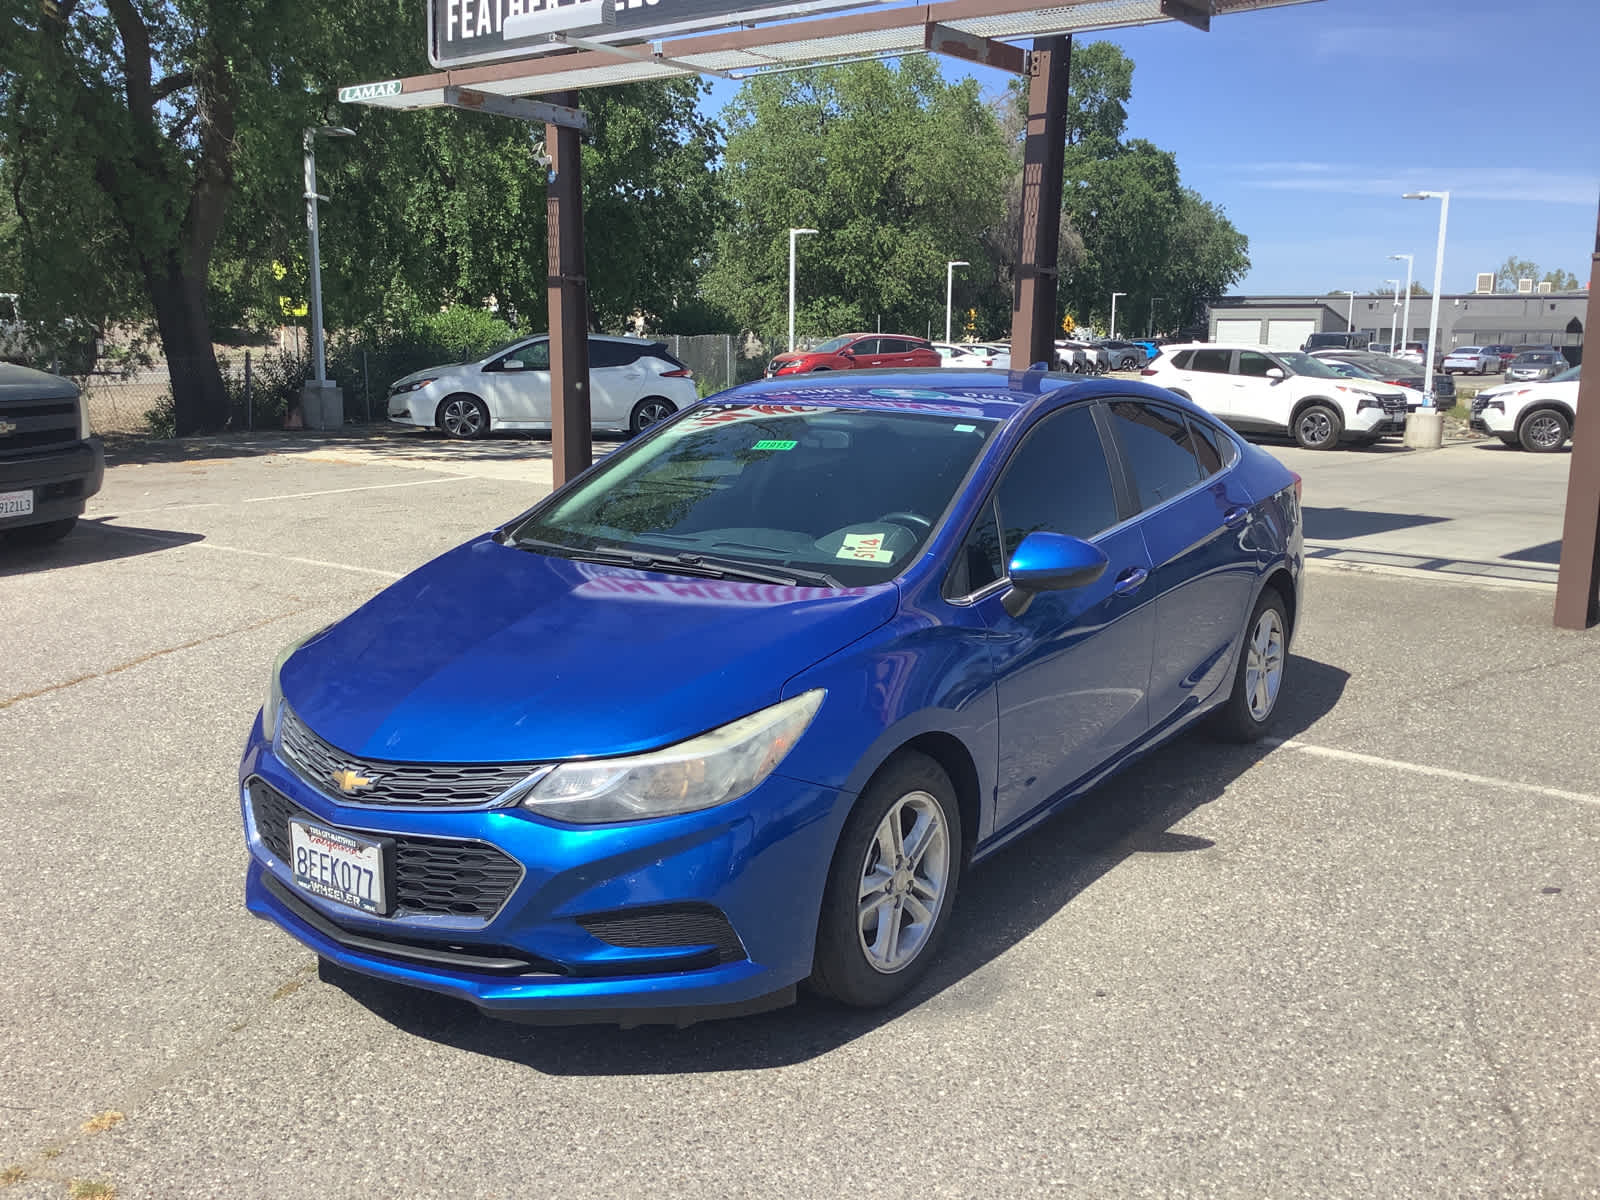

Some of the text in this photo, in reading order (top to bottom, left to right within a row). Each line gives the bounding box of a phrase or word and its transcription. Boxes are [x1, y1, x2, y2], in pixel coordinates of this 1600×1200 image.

[344, 82, 397, 100] LAMAR
[853, 538, 881, 559] 5114
[296, 846, 374, 900] 8EEK077
[310, 880, 361, 905] WHEELER
